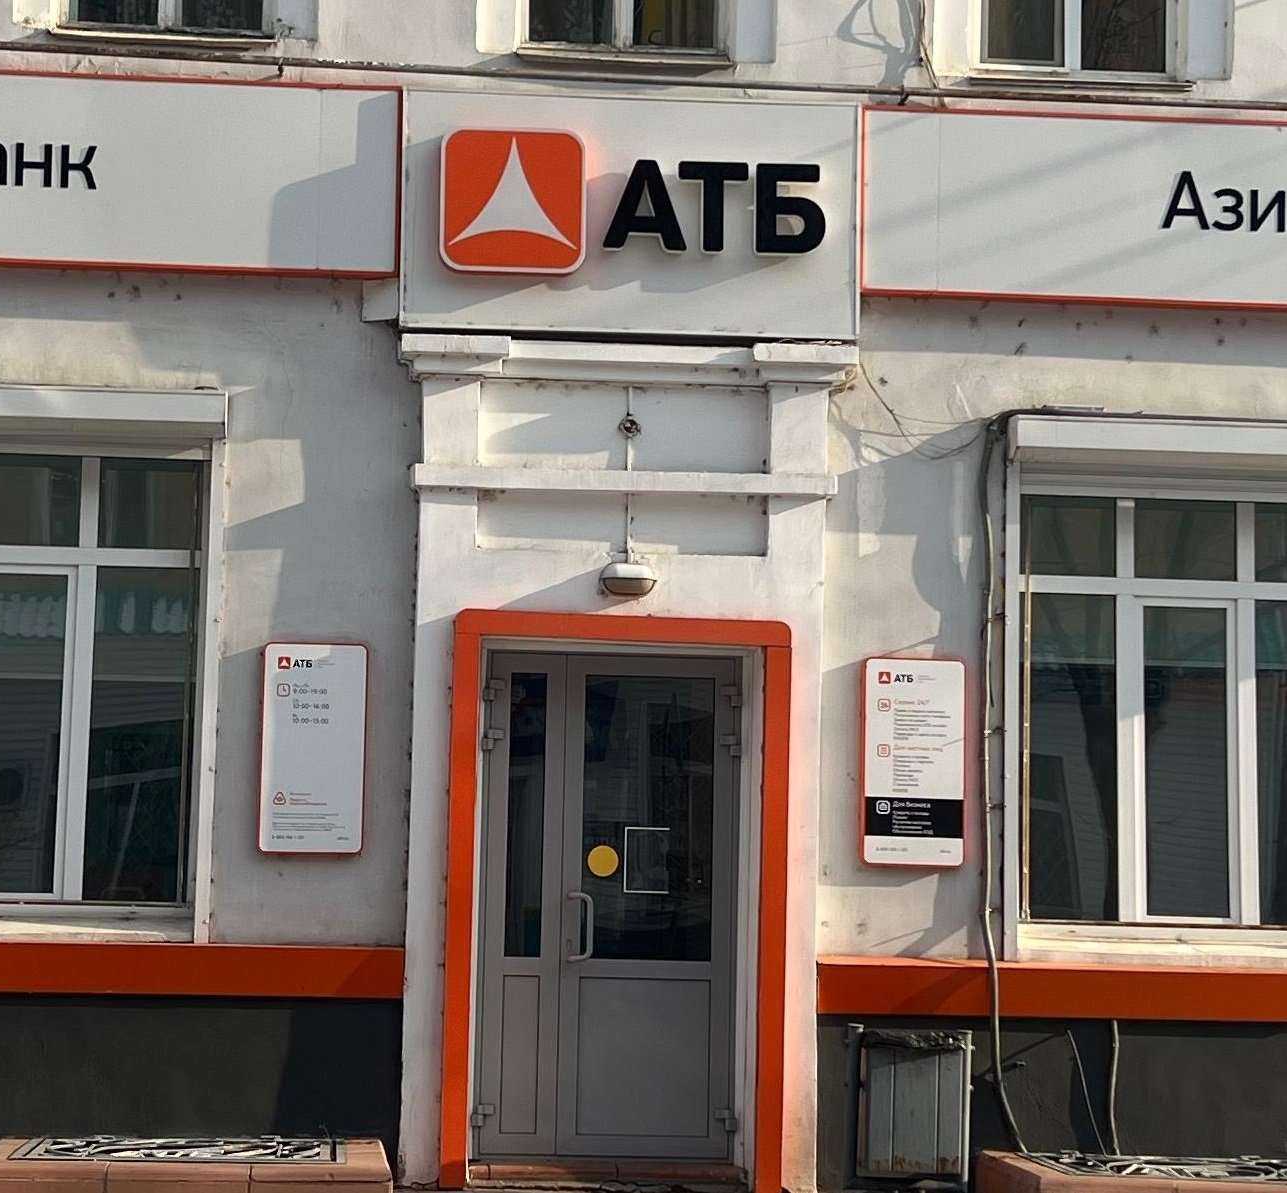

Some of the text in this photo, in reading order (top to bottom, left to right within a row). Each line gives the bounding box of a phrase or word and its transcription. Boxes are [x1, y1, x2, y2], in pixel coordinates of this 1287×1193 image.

[602, 159, 827, 254] АТБ
[292, 659, 313, 668] АТБ
[894, 674, 914, 683] АТБ
